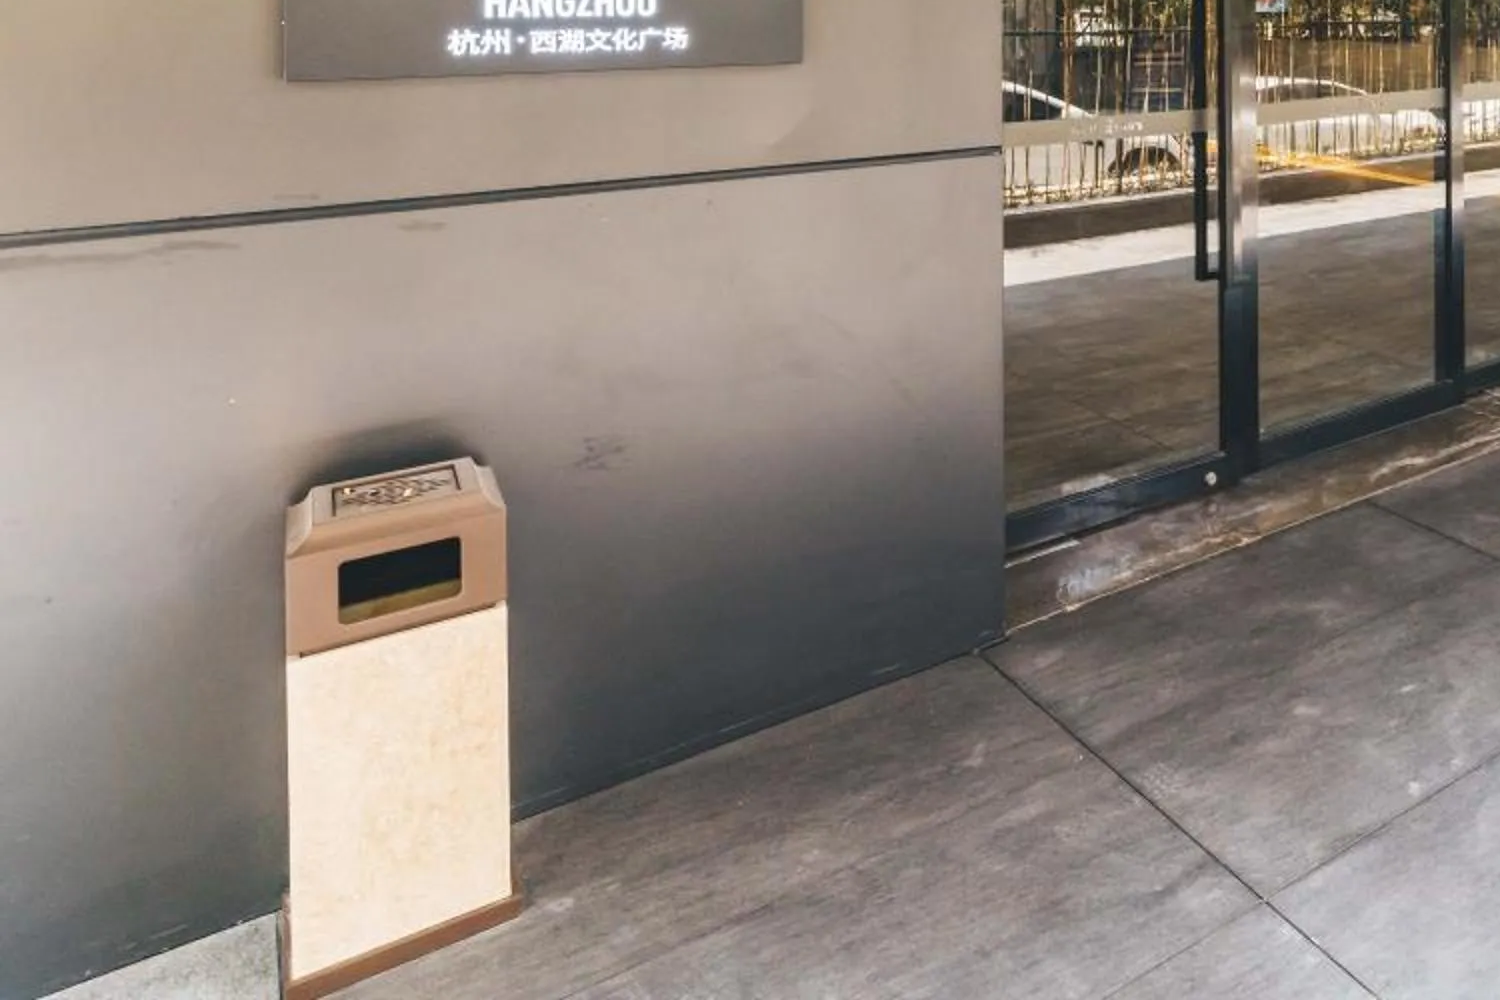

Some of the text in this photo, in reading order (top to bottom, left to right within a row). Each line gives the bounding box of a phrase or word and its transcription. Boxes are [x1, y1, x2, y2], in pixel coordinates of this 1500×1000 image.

[447, 27, 690, 56] 杭州·西湖文化广场
